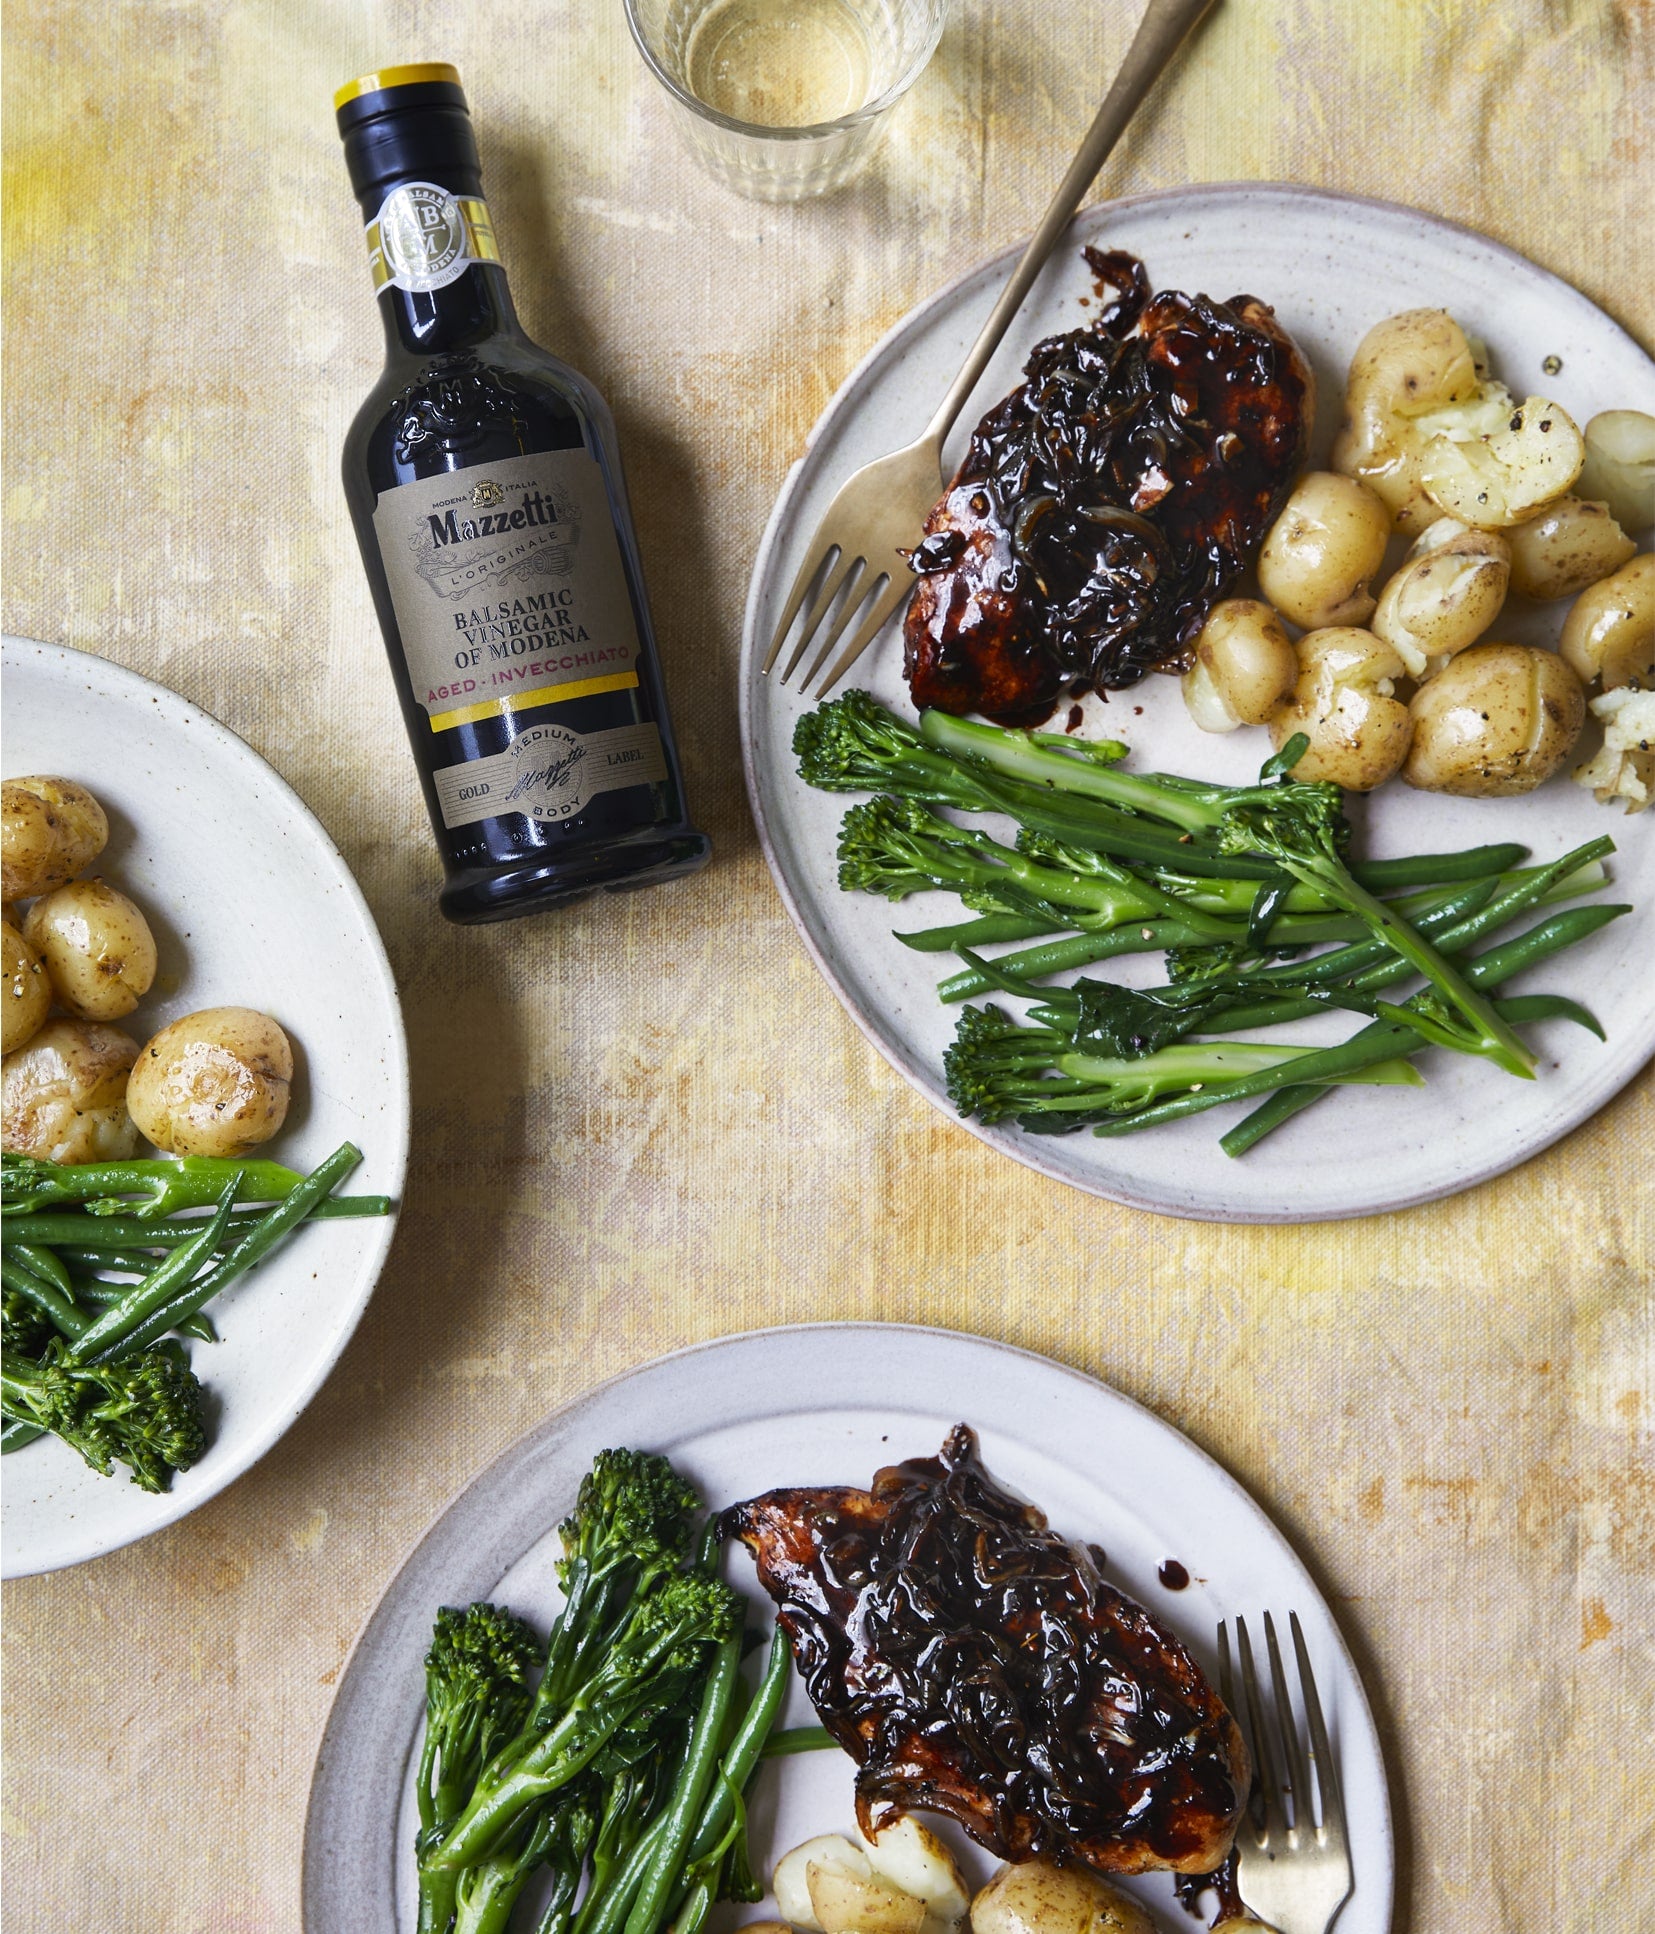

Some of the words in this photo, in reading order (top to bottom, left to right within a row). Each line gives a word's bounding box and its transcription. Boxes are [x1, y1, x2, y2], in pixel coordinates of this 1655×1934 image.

[421, 206, 440, 226] B
[505, 480, 538, 492] ITALIA
[432, 495, 467, 509] MODENA
[425, 491, 559, 550] Mazzetti
[451, 531, 558, 585] L'ORIGINALE
[453, 589, 574, 631] BALSAMIC
[463, 609, 574, 647] VINEGAR
[454, 647, 483, 669] OF
[488, 625, 591, 661] MODENA
[428, 679, 477, 703] AGED
[492, 646, 630, 685] INVECCHIATO
[511, 728, 577, 759] MEDIUM
[606, 748, 646, 766] LABEL
[458, 783, 490, 801] GOLD
[533, 796, 581, 818] BODY
